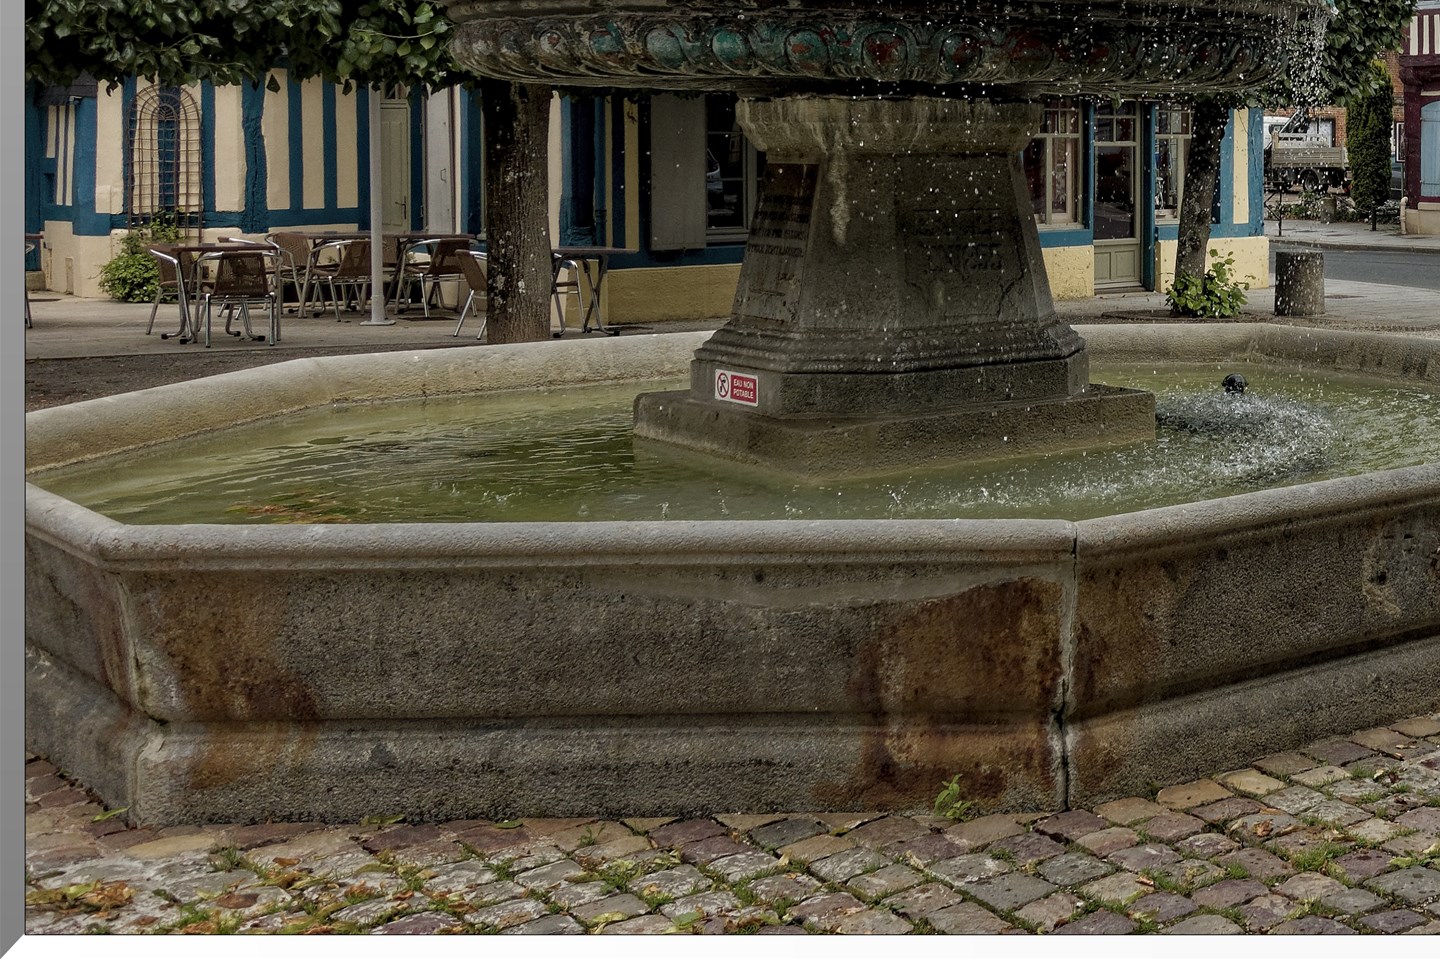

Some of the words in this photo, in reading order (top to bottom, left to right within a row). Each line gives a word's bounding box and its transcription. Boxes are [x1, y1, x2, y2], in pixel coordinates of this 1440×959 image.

[733, 378, 743, 387] EAU
[743, 381, 754, 390] NON
[733, 389, 754, 399] POTABLE
